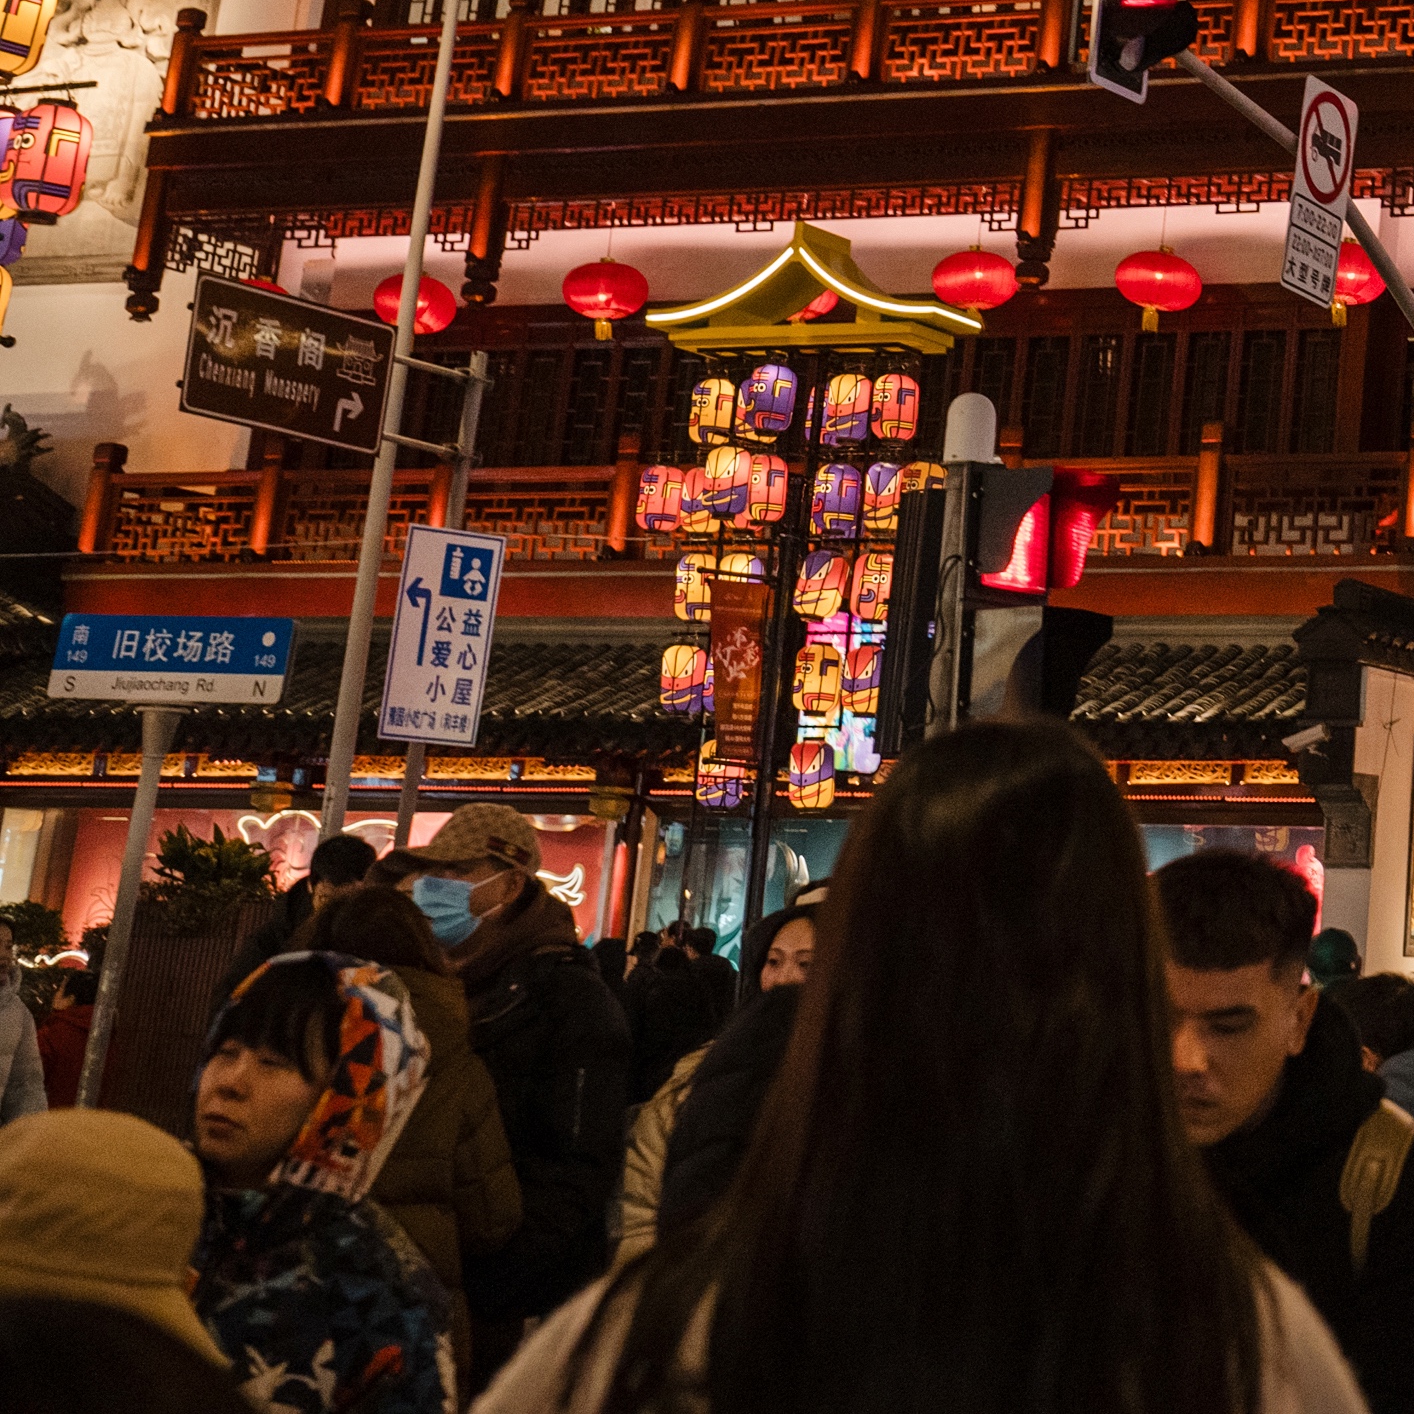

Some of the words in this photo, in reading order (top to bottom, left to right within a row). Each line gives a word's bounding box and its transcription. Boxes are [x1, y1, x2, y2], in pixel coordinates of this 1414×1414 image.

[206, 304, 326, 371] 沉香阁
[72, 623, 91, 646] 南
[111, 627, 236, 664] 旧校场路
[65, 648, 88, 664] 149
[253, 653, 277, 669] 149
[63, 674, 77, 693] S
[111, 675, 190, 695] Jiujiaochang
[251, 679, 268, 698] N
